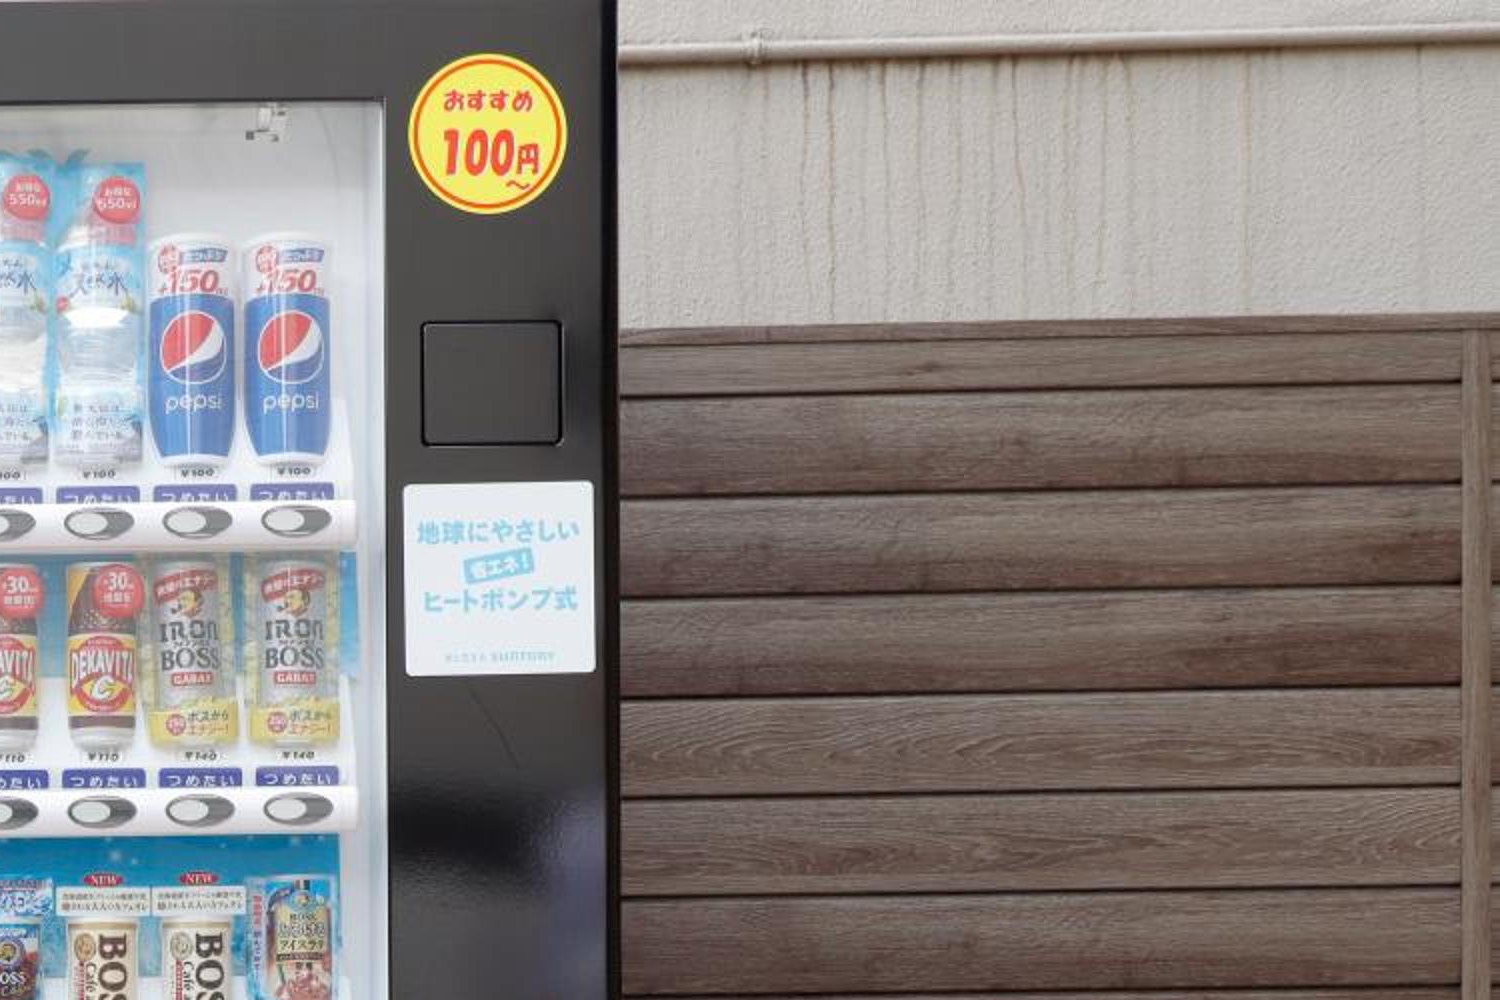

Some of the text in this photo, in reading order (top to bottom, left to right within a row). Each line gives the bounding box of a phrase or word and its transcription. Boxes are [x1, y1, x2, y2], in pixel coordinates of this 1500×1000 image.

[443, 89, 533, 112] おすすめ
[165, 393, 223, 414] pepsi
[263, 392, 319, 413] pepsi
[417, 519, 581, 544] 地球にやさしい
[423, 585, 579, 612] ヒートポンプ式
[161, 648, 221, 671] BOSS
[265, 648, 325, 670] BOSS
[70, 775, 138, 788] つめたい
[167, 774, 235, 787] つめたい
[263, 772, 332, 785] つめたい
